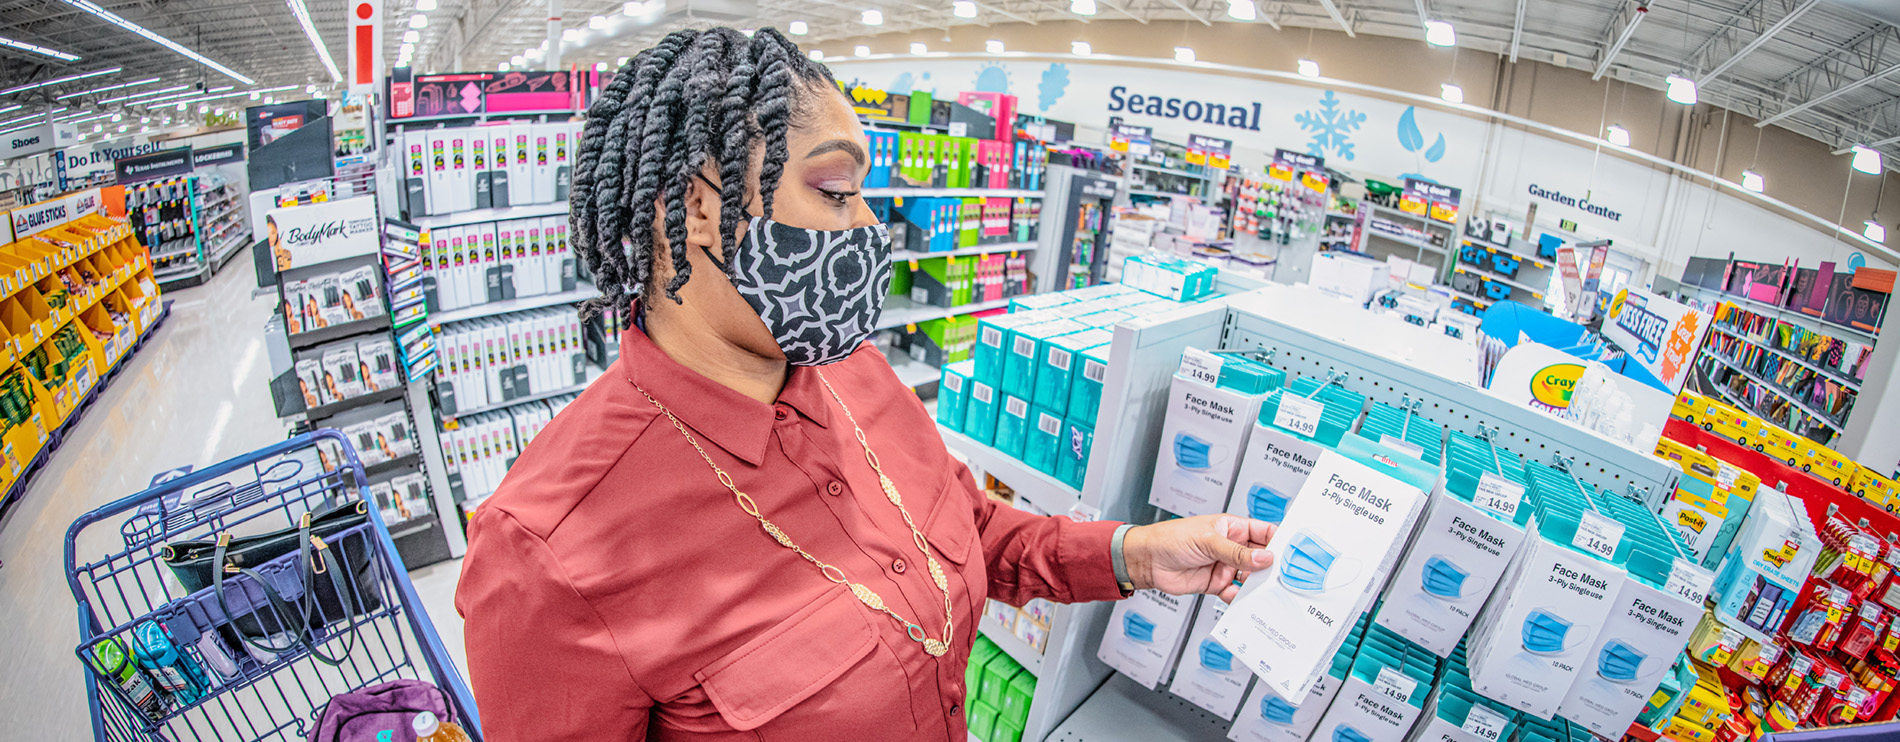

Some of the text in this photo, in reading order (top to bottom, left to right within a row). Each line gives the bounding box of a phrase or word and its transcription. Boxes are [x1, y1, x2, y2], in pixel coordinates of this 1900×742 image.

[1108, 86, 1262, 131] Seasonal
[12, 136, 40, 149] Shoes
[69, 141, 161, 169] Do It Yourself
[1528, 183, 1622, 222] Garden Center
[28, 205, 66, 227] GLUE STICKS
[1619, 303, 1667, 349] MESS FREE
[1677, 321, 1692, 345] Great
[1192, 369, 1216, 383] 14.99
[1546, 375, 1576, 390] Cray
[1184, 404, 1200, 414] 3-Ply
[1201, 409, 1220, 420] Single
[1185, 393, 1234, 415] Face Mask
[1529, 398, 1568, 419] COLOR
[1289, 418, 1314, 434] 14.99
[1266, 443, 1290, 459] Face
[1264, 454, 1281, 466] 3-Ply
[1283, 461, 1304, 474] Single
[1211, 477, 1223, 486] PACK
[1328, 473, 1392, 512] Face Mask
[1321, 488, 1385, 525] 3-Ply Single use
[1488, 497, 1515, 513] 14.99
[1680, 512, 1704, 528] Post-it
[1447, 526, 1500, 556] 3-Ply Single use
[1452, 516, 1505, 548] Face Mask
[1587, 537, 1613, 556] 14.99
[1552, 563, 1608, 590] Face Mask
[1752, 559, 1799, 587] DRY ERASE SHEETS
[1548, 575, 1603, 600] 3-Ply Single use
[1678, 585, 1703, 604] 14.99
[1159, 592, 1179, 606] Mask
[1307, 605, 1334, 627] 10 PACK
[1455, 608, 1469, 618] PACK
[1627, 609, 1679, 636] 3-Ply Single use
[1632, 598, 1685, 627] Face Mask
[1250, 613, 1268, 630] GLOBAL
[1268, 626, 1279, 637] MED
[1278, 634, 1297, 650] GROUP
[1558, 662, 1573, 672] PACK
[1384, 687, 1408, 703] 14.99
[1630, 690, 1645, 700] PACK
[1358, 693, 1404, 720] Face Mask
[1370, 710, 1388, 722] Single
[1388, 719, 1400, 727] use
[1474, 725, 1498, 740] 14.99
